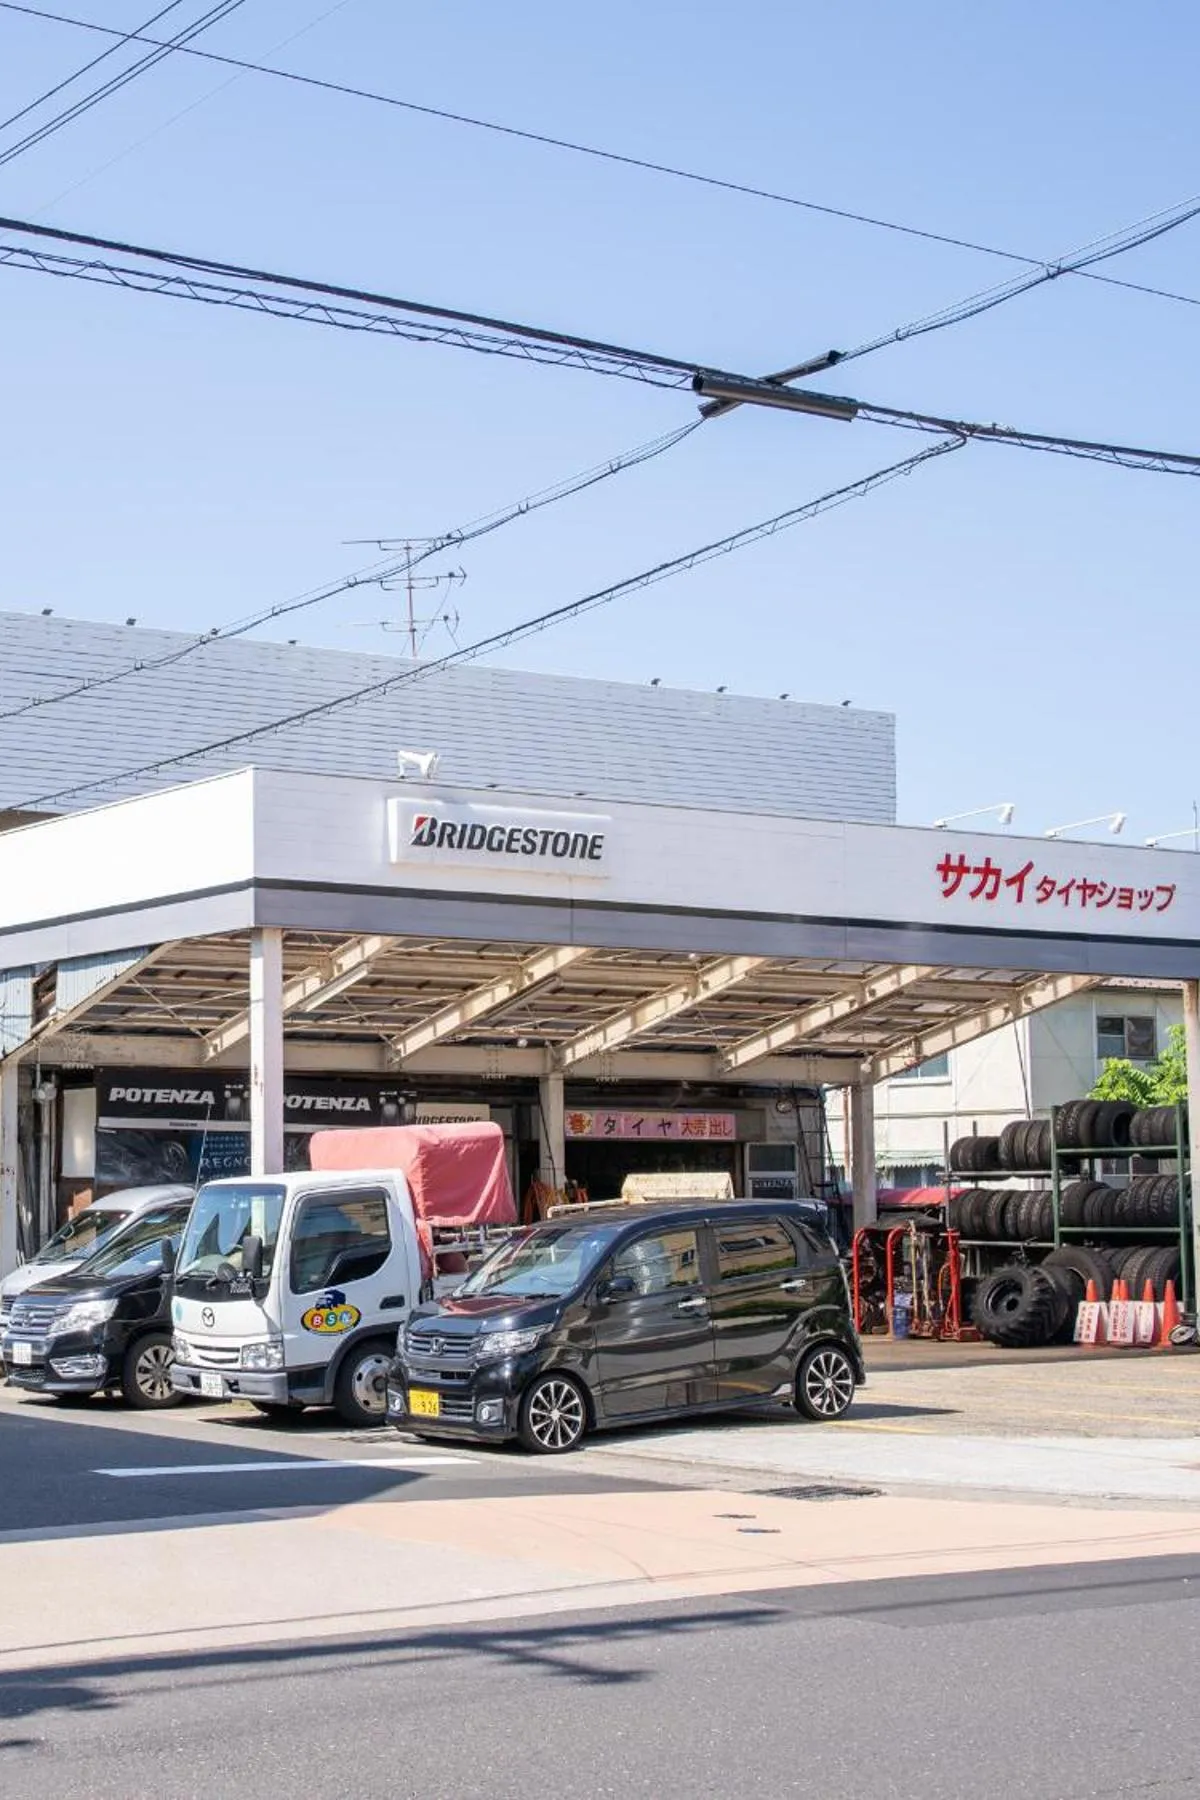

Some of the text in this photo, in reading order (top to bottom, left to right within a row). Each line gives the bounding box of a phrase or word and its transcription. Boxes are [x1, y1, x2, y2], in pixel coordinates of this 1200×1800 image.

[411, 817, 605, 860] BRIDGESTONE
[109, 1087, 216, 1105] POTENZA
[284, 1095, 372, 1112] OTENZA
